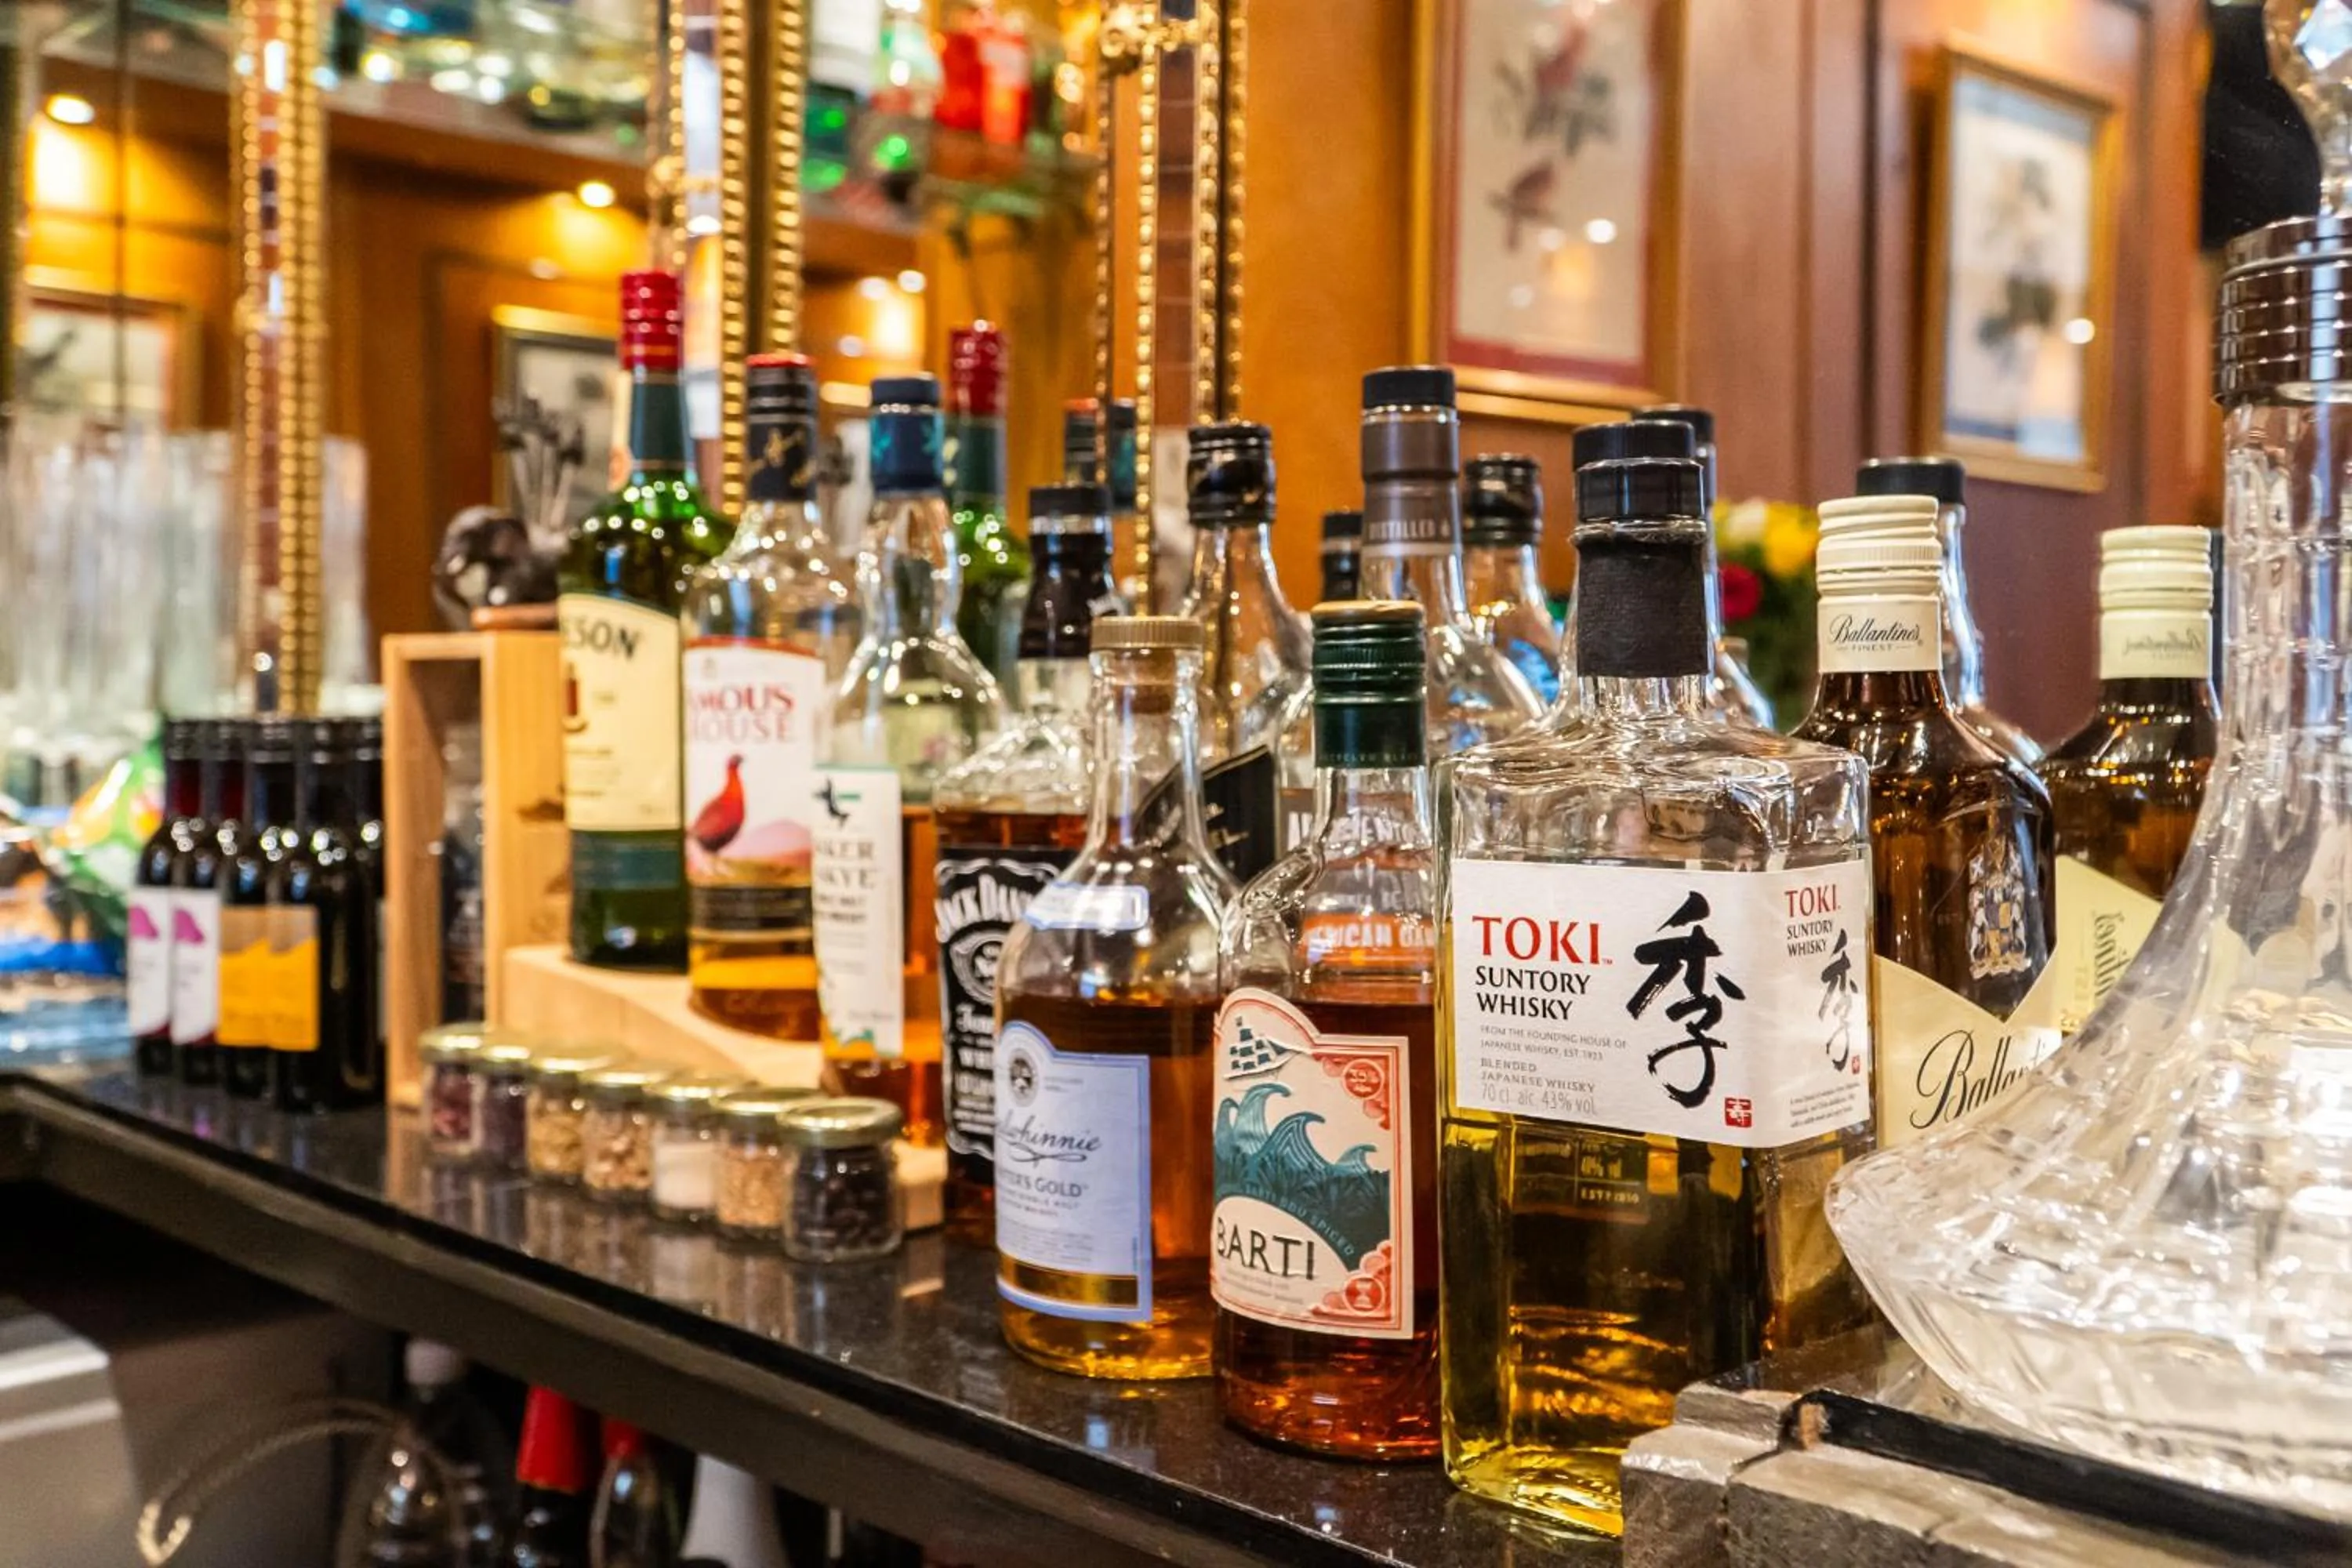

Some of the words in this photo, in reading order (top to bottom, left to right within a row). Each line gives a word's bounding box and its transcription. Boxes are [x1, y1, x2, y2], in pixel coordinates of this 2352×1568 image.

[1829, 614, 1919, 643] Ballantine's
[1784, 884, 1837, 918] TOKI
[1472, 916, 1599, 964] TOKI
[1787, 920, 1833, 940] SUNTORY
[1788, 938, 1827, 956] WHISKY
[1475, 965, 1591, 995] SUNTORY
[1476, 993, 1573, 1021] WHISKY
[1625, 890, 1747, 1109] 季
[1480, 1039, 1522, 1052] JAPANESE
[1480, 1058, 1537, 1073] BLENDED
[1480, 1071, 1543, 1087] JAPANESE
[1545, 1078, 1595, 1094] WHISKY
[1541, 1090, 1572, 1112] 43%
[1035, 1177, 1082, 1198] GOLD
[1217, 1217, 1315, 1280] BARTI
